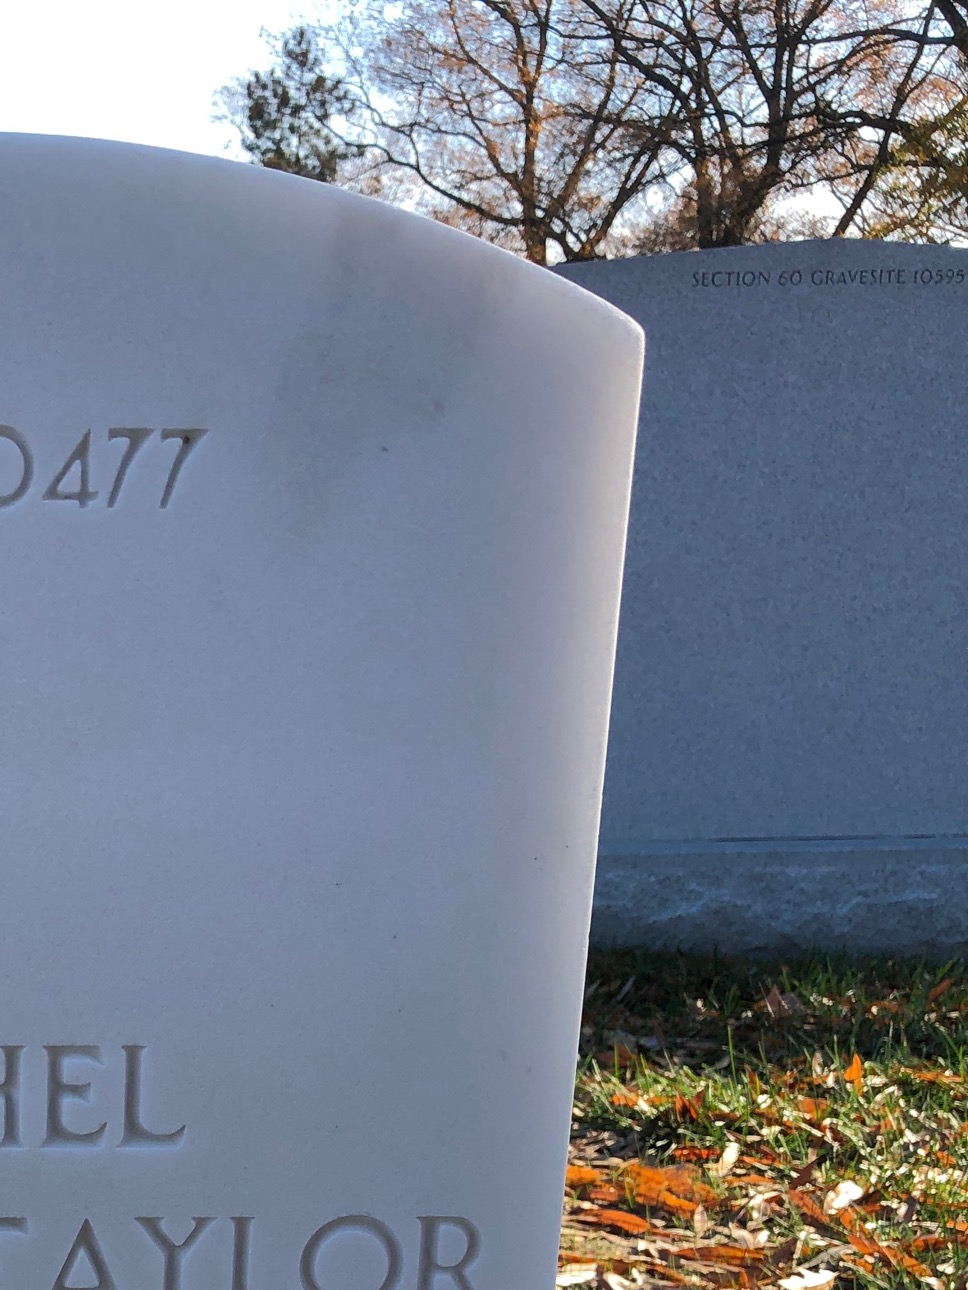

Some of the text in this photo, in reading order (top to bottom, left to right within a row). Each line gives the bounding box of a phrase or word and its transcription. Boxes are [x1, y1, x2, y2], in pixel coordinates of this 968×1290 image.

[691, 270, 771, 288] SECTION
[777, 269, 803, 287] 60
[811, 268, 906, 286] GRAVESITE
